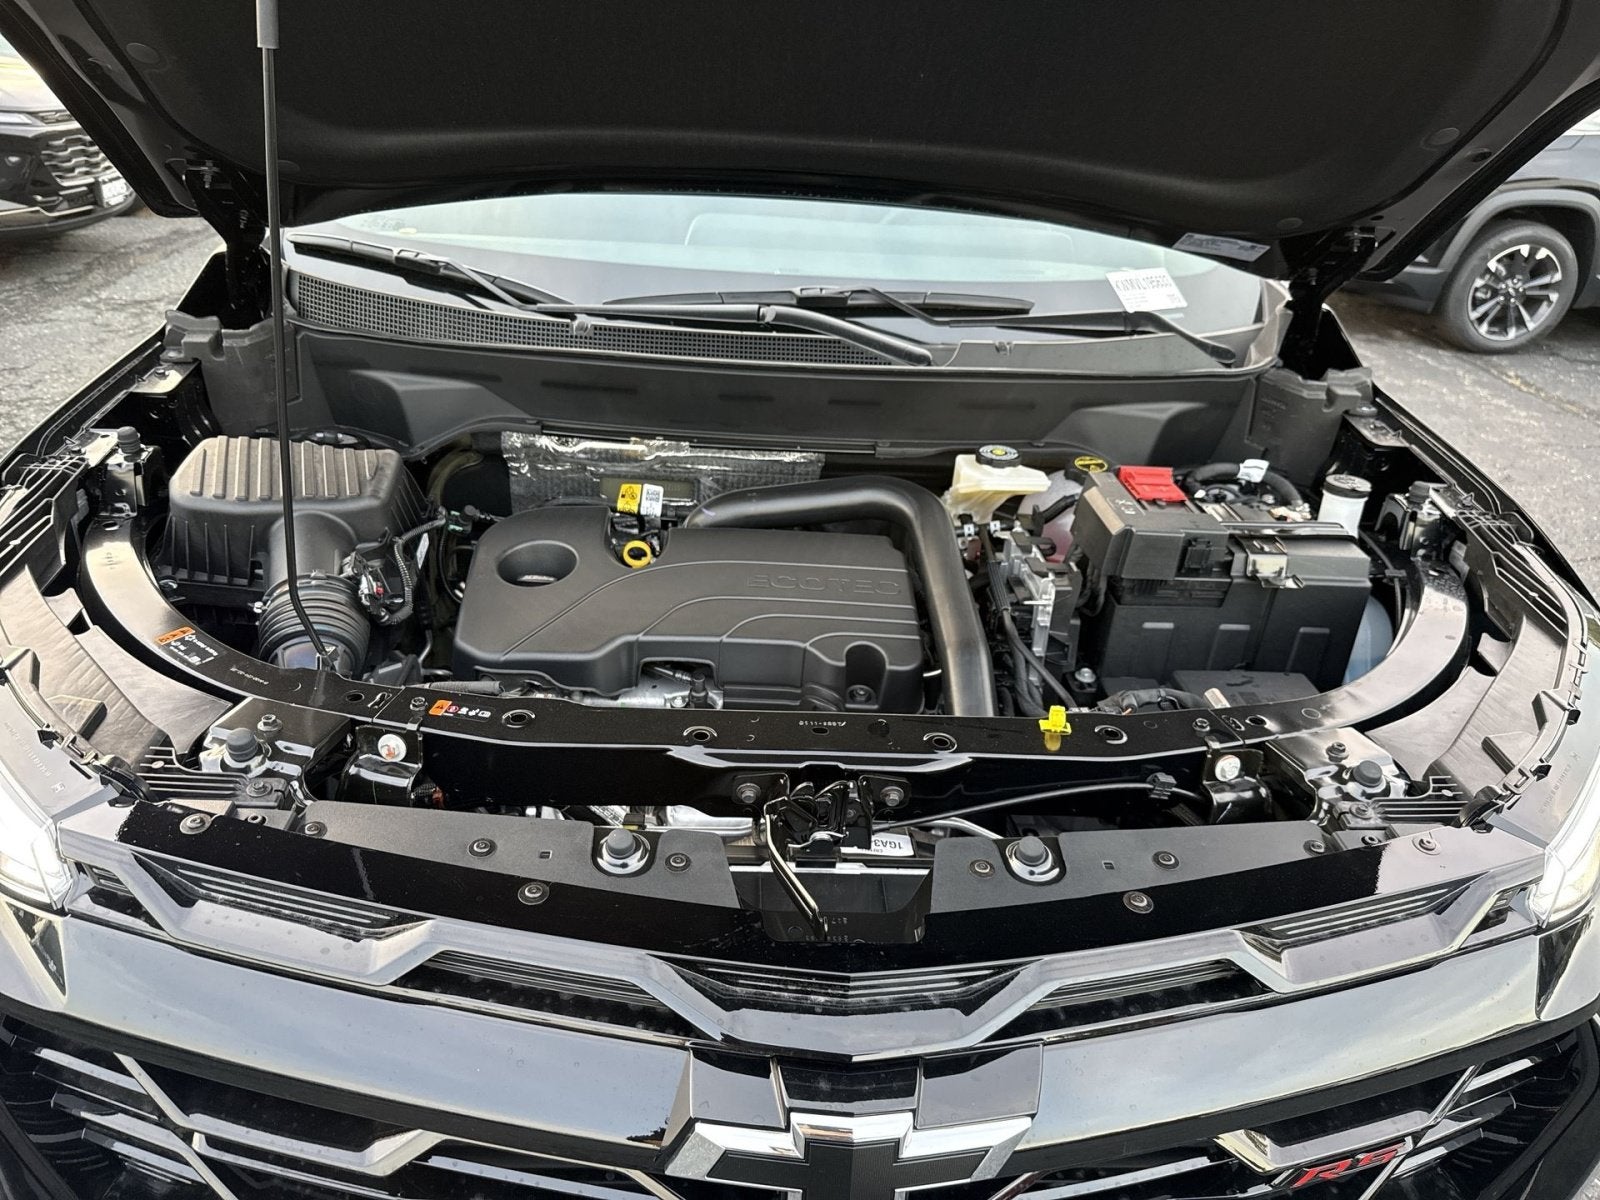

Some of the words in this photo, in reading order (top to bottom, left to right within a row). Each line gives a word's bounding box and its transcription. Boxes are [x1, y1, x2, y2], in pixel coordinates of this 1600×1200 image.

[746, 573, 902, 595] ECOTEC
[872, 838, 904, 850] 1GA3
[1290, 1142, 1406, 1188] RS
